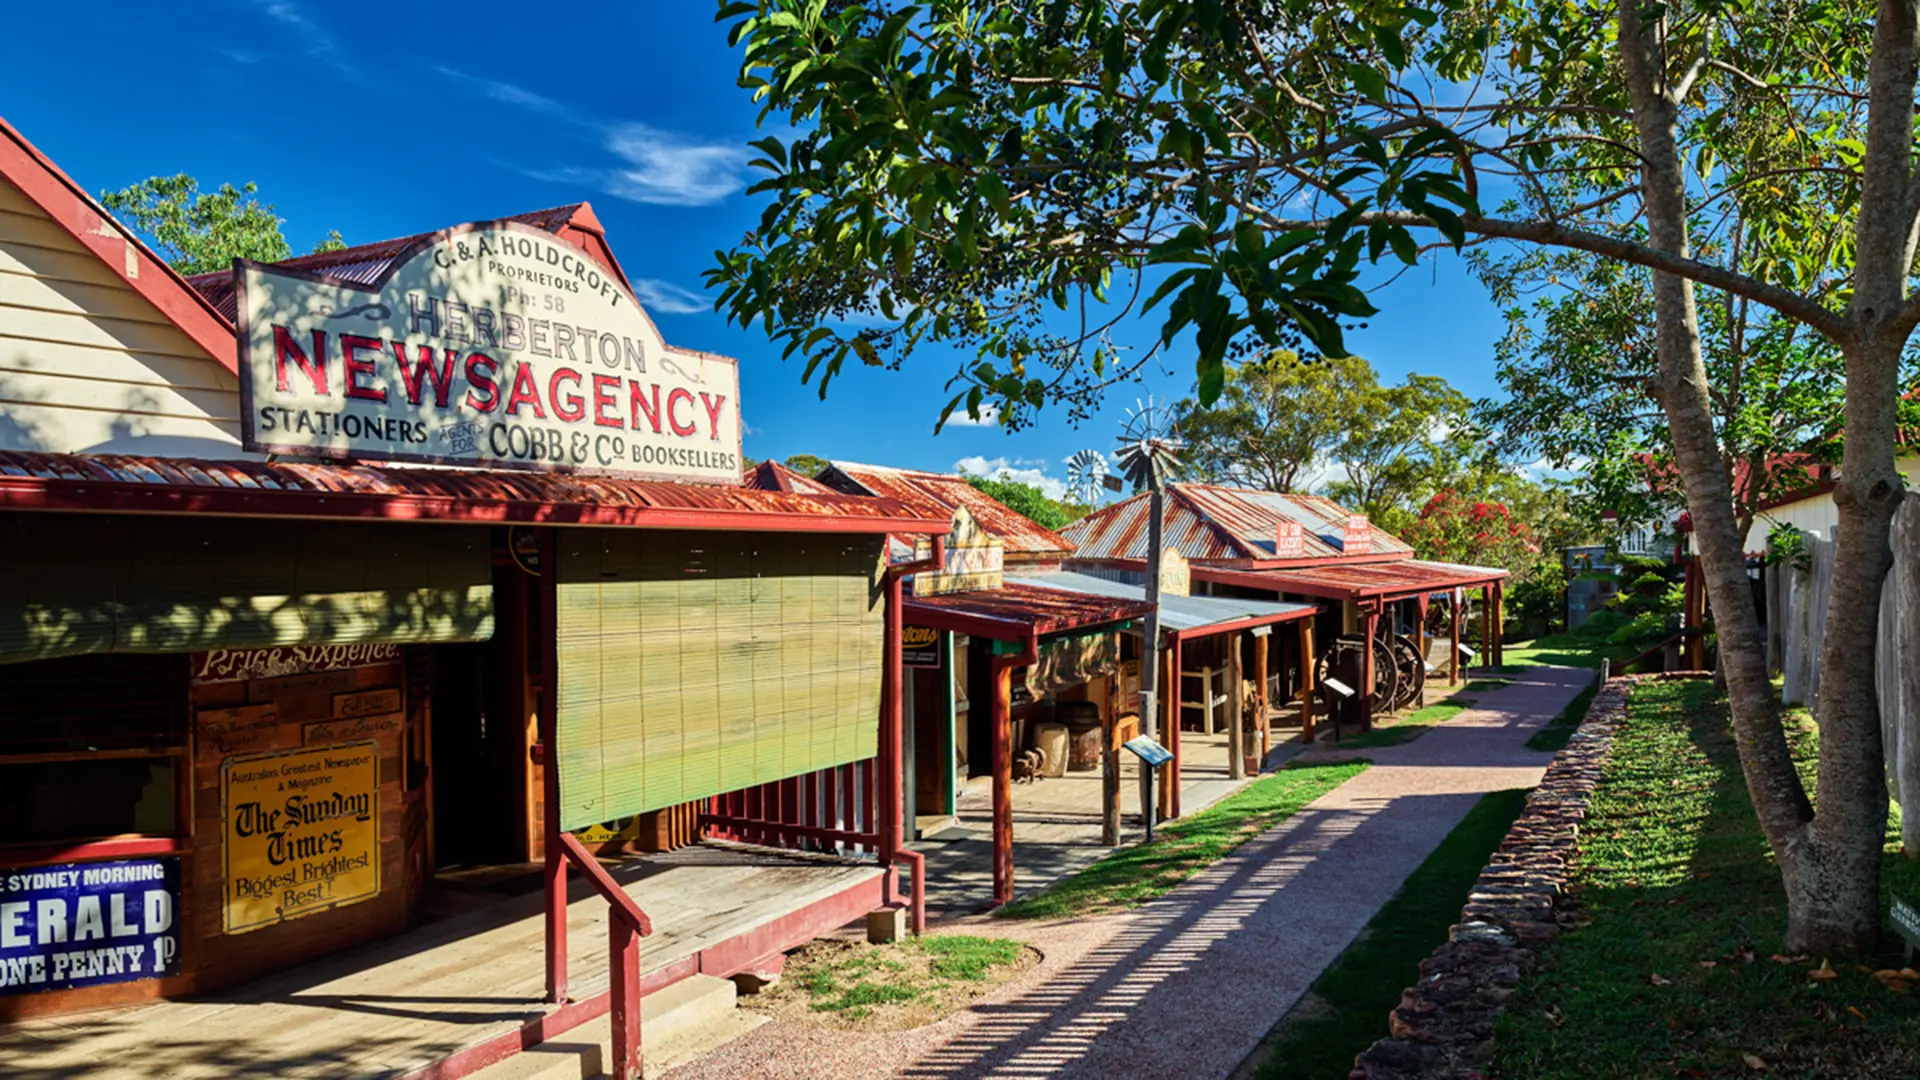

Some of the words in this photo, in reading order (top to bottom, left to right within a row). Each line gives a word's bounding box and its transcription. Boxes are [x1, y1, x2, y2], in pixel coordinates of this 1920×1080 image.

[434, 248, 457, 269] C.
[457, 240, 474, 262] &
[501, 236, 624, 307] HOLDCROFT
[488, 260, 580, 294] PROPRIETORS
[508, 285, 536, 307] Ph:
[543, 293, 566, 315] 58
[409, 293, 648, 374] HERBERTON
[270, 323, 727, 442] NEWSAGENCY
[260, 406, 428, 444] STATIONERS
[439, 420, 485, 441] AGENTS
[488, 422, 565, 461] COBB
[452, 438, 478, 452] FOR
[570, 430, 590, 464] &
[632, 444, 737, 471] BOOKSELLERS
[280, 761, 321, 777] Greatest
[324, 755, 371, 770] Newspaper
[288, 775, 332, 792] Magazine
[235, 802, 281, 838] The
[283, 791, 370, 829] Sunday
[266, 828, 343, 866] Times
[8, 870, 81, 892] SYDNEY
[84, 863, 165, 886] MORNING
[236, 867, 297, 899] Biggest
[303, 850, 369, 881] Brightest
[0, 889, 173, 949] ERALD
[52, 944, 145, 981] PENNY
